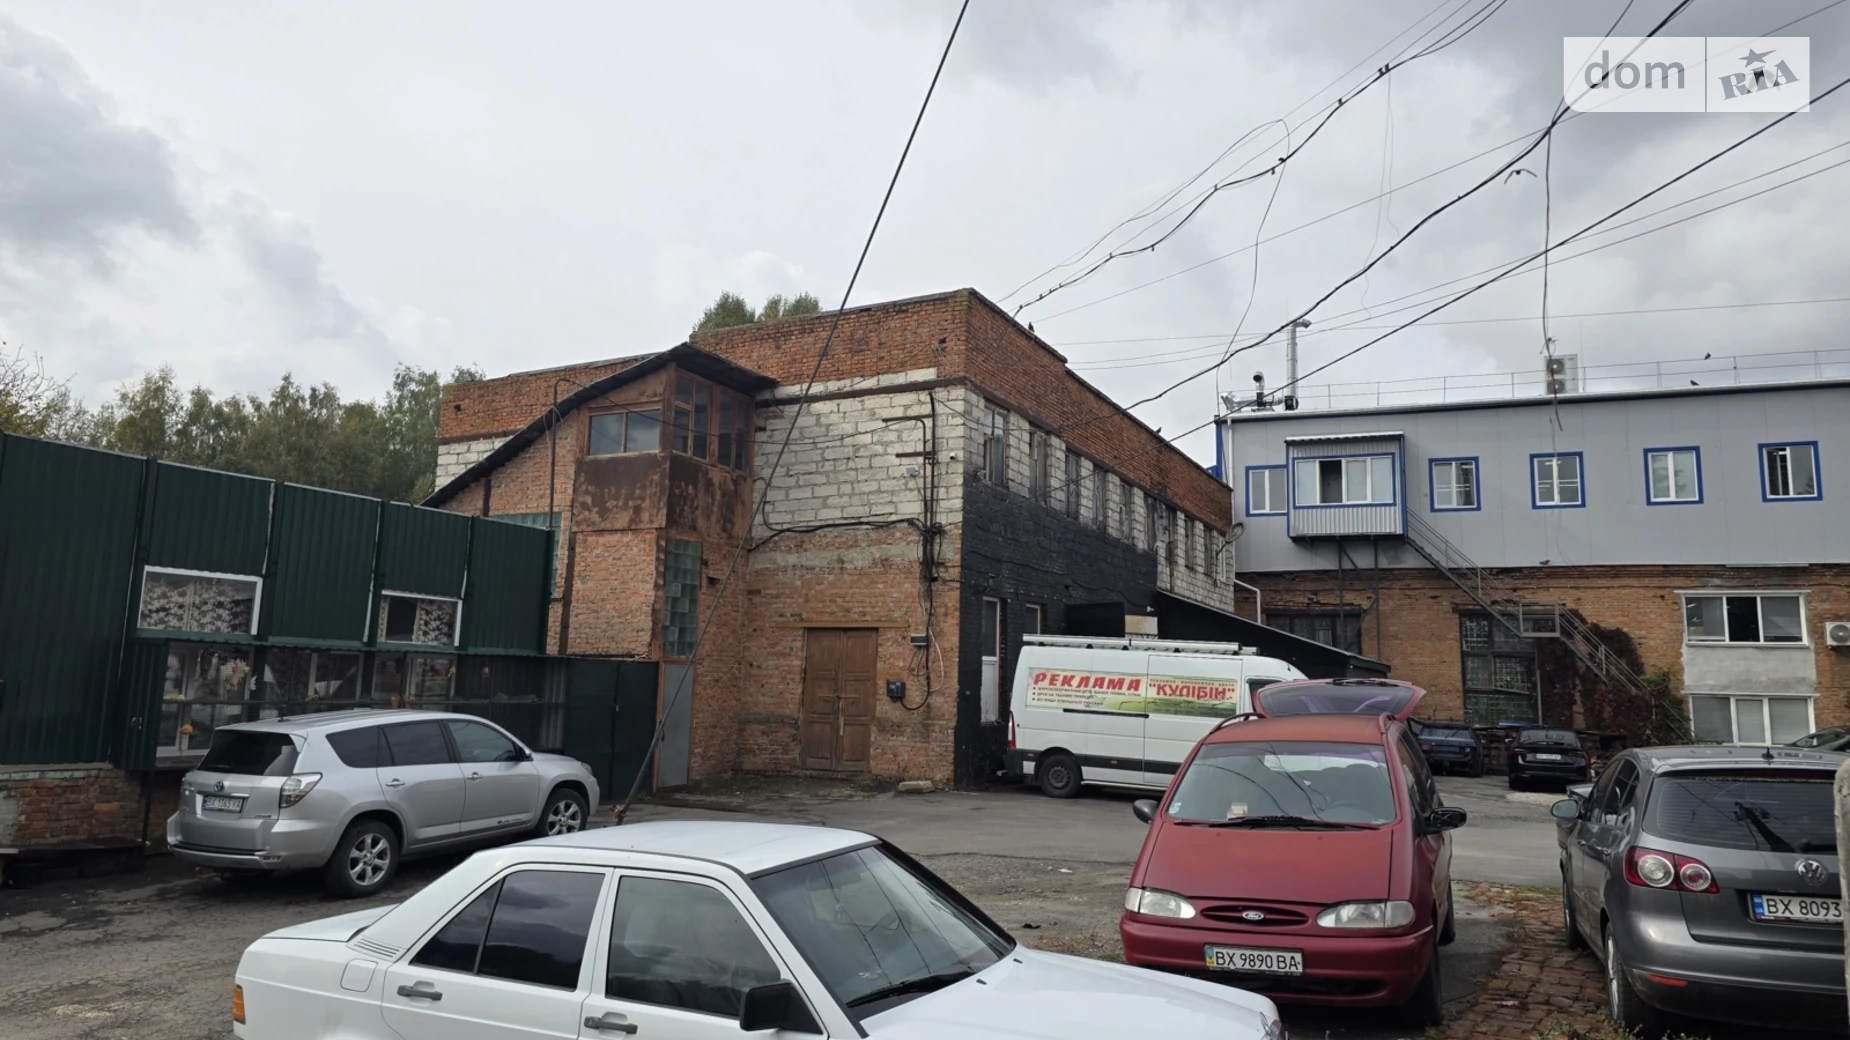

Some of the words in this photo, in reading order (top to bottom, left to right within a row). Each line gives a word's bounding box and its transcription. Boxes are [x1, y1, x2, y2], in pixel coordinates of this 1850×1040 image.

[1033, 671, 1142, 692] РЕКЛАМА
[1766, 898, 1794, 915] BX
[1798, 900, 1842, 917] 8093
[1215, 951, 1237, 967] BX
[1239, 953, 1274, 969] 9890
[1276, 955, 1299, 971] BA
